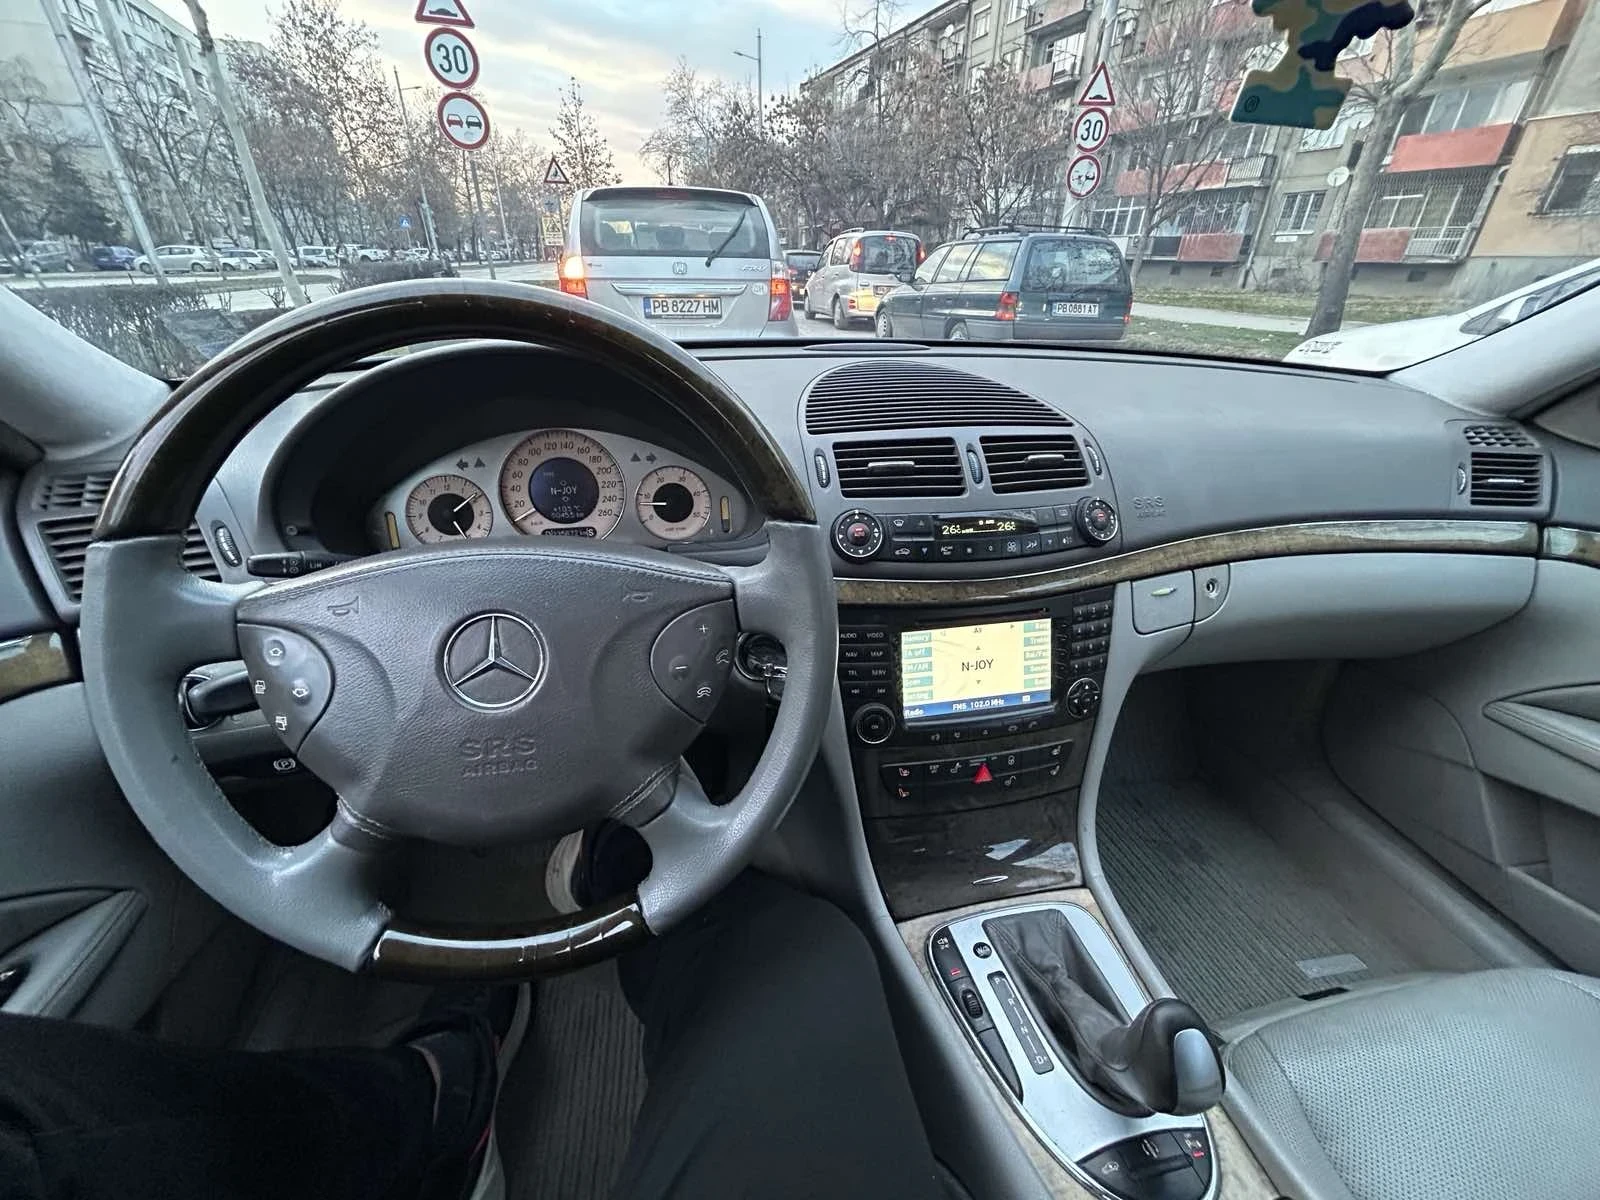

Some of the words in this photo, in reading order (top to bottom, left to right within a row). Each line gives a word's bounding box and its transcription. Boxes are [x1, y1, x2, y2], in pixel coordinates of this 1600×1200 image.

[436, 43, 469, 75] 30
[1080, 119, 1103, 142] 30
[652, 299, 670, 313] PB
[671, 299, 701, 313] 8227
[702, 299, 720, 313] HM
[1057, 303, 1068, 313] PB
[543, 442, 558, 451] 120
[559, 441, 574, 450] 140
[577, 446, 591, 455] 160
[528, 448, 542, 457] 100
[518, 458, 529, 466] 80
[588, 455, 602, 464] 180
[512, 471, 523, 479] 60
[597, 466, 612, 475] 200
[510, 484, 521, 493] 40
[601, 481, 617, 489] 220
[550, 486, 578, 496] N-JOY
[513, 499, 525, 509] 20
[602, 494, 618, 504] 240
[1133, 495, 1165, 510] SRS
[597, 508, 613, 518] 260
[961, 658, 994, 672] N-JOY
[459, 735, 537, 761] SRS
